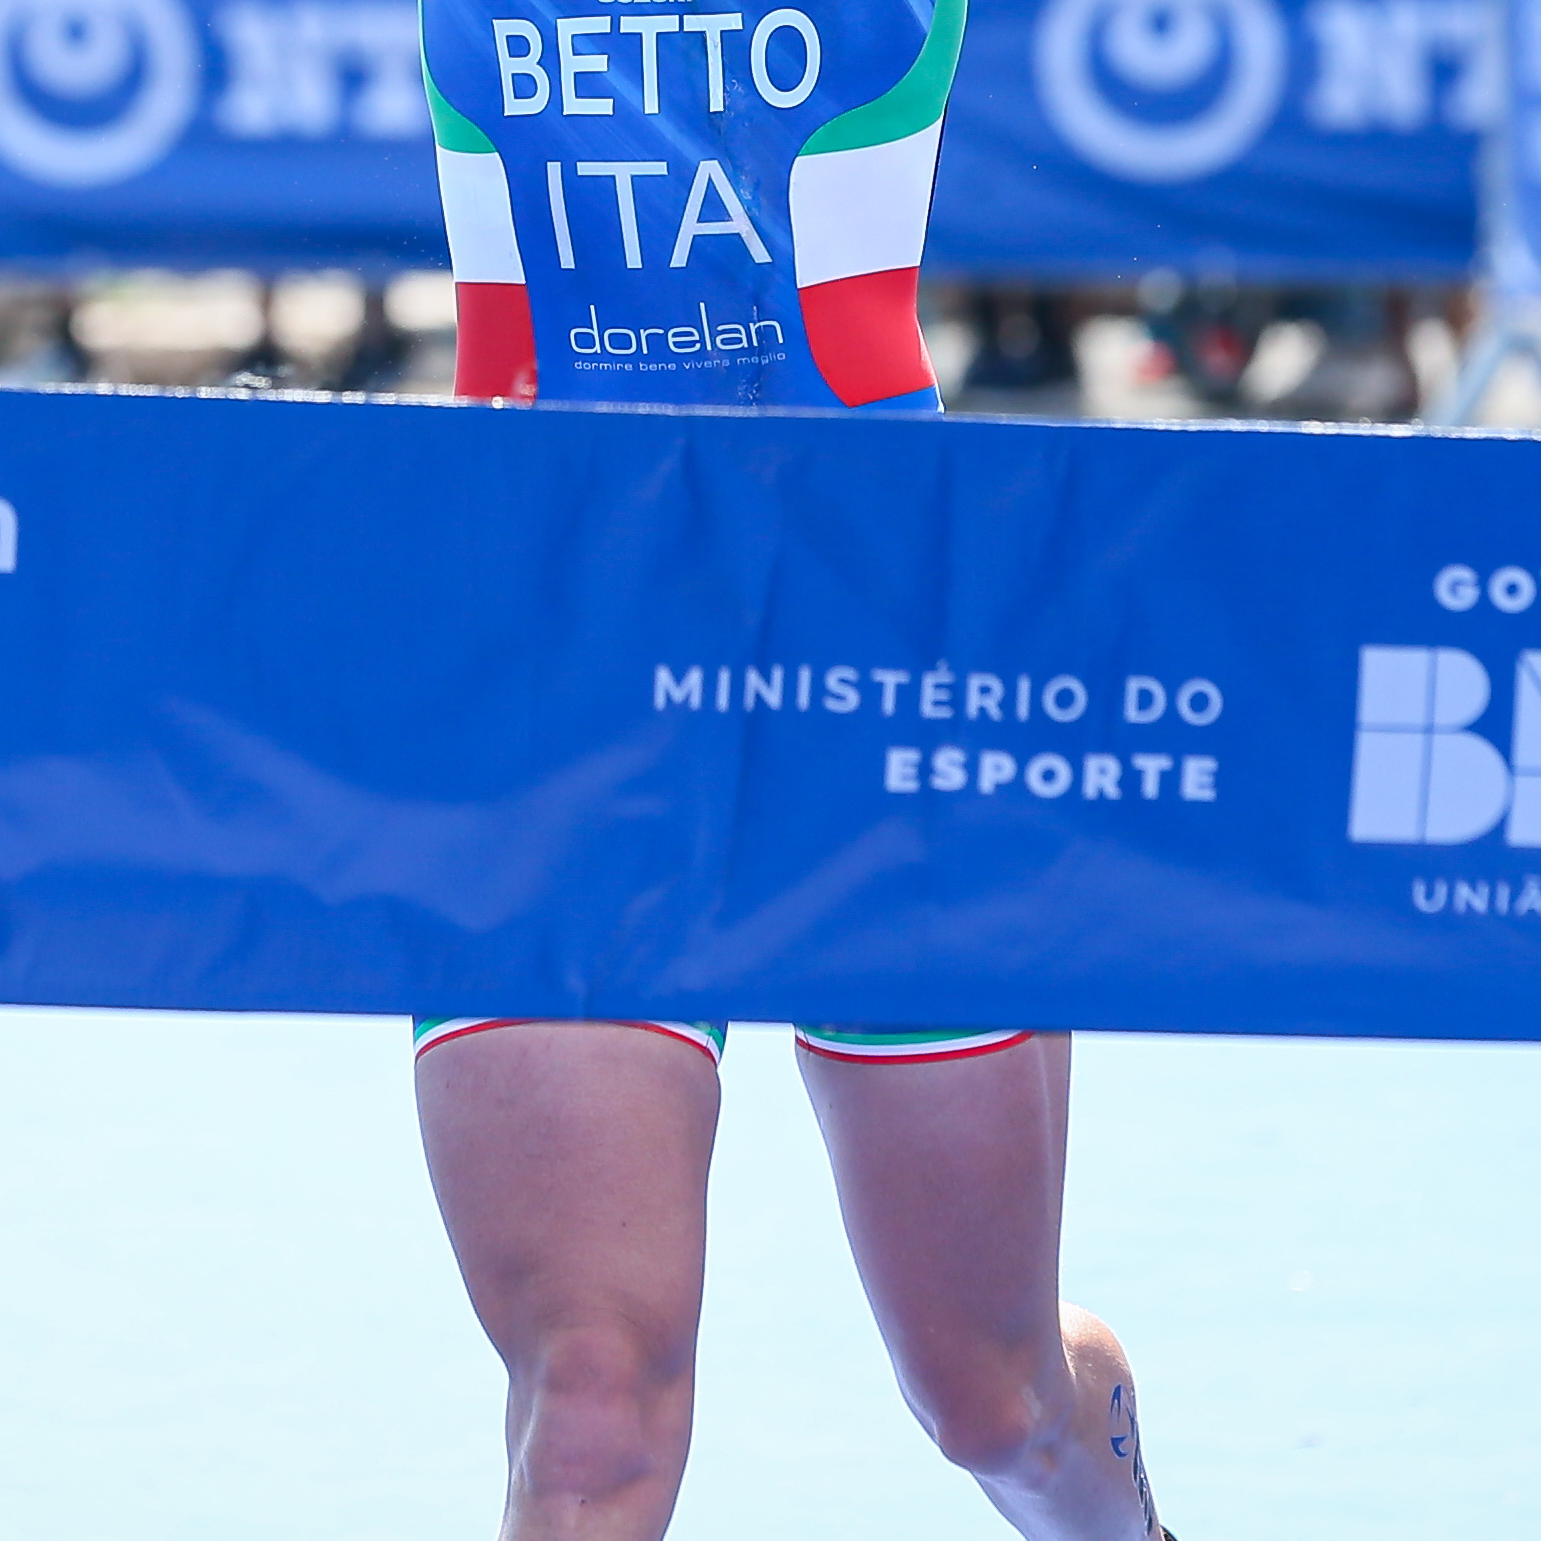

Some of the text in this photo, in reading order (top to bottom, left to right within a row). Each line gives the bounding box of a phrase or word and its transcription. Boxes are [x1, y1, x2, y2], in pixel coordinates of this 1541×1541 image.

[491, 8, 821, 117] BETTO
[546, 159, 773, 269] ITA
[569, 301, 784, 355] dorelan
[574, 352, 786, 371] dormire bene vivere meglio
[653, 660, 1224, 727] MINISTÉRIO DO
[884, 745, 1218, 802] ESPORTE
